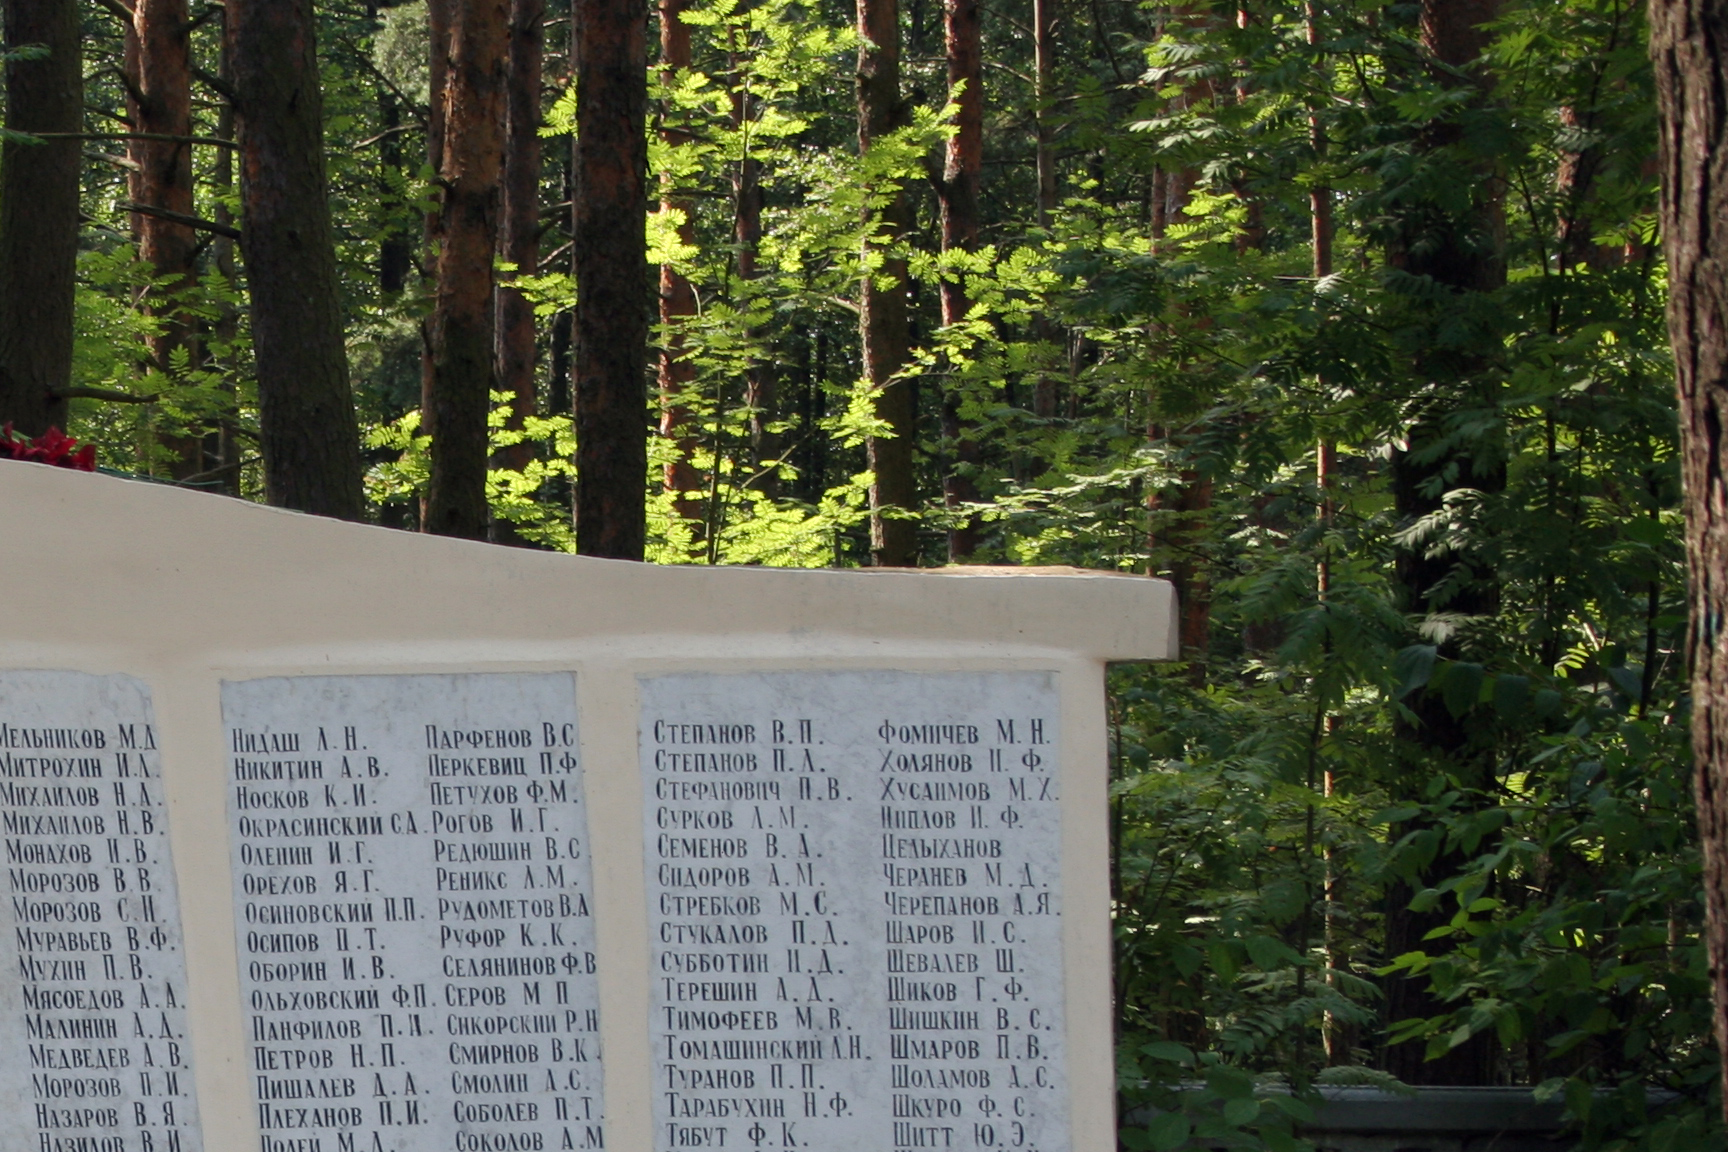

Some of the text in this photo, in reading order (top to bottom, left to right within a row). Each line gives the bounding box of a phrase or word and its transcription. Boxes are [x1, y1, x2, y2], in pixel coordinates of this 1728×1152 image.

[432, 810, 493, 834] РОГОВ
[9, 868, 100, 893] МОРОЗОВ
[445, 983, 506, 1007] СЕРОВ
[254, 1046, 333, 1070] ПЕТРОВ
[449, 1042, 539, 1065] СМИРНОВ
[35, 1103, 119, 1128] НАЗАРОВ
[456, 1129, 543, 1152] СОКОЛОВ
